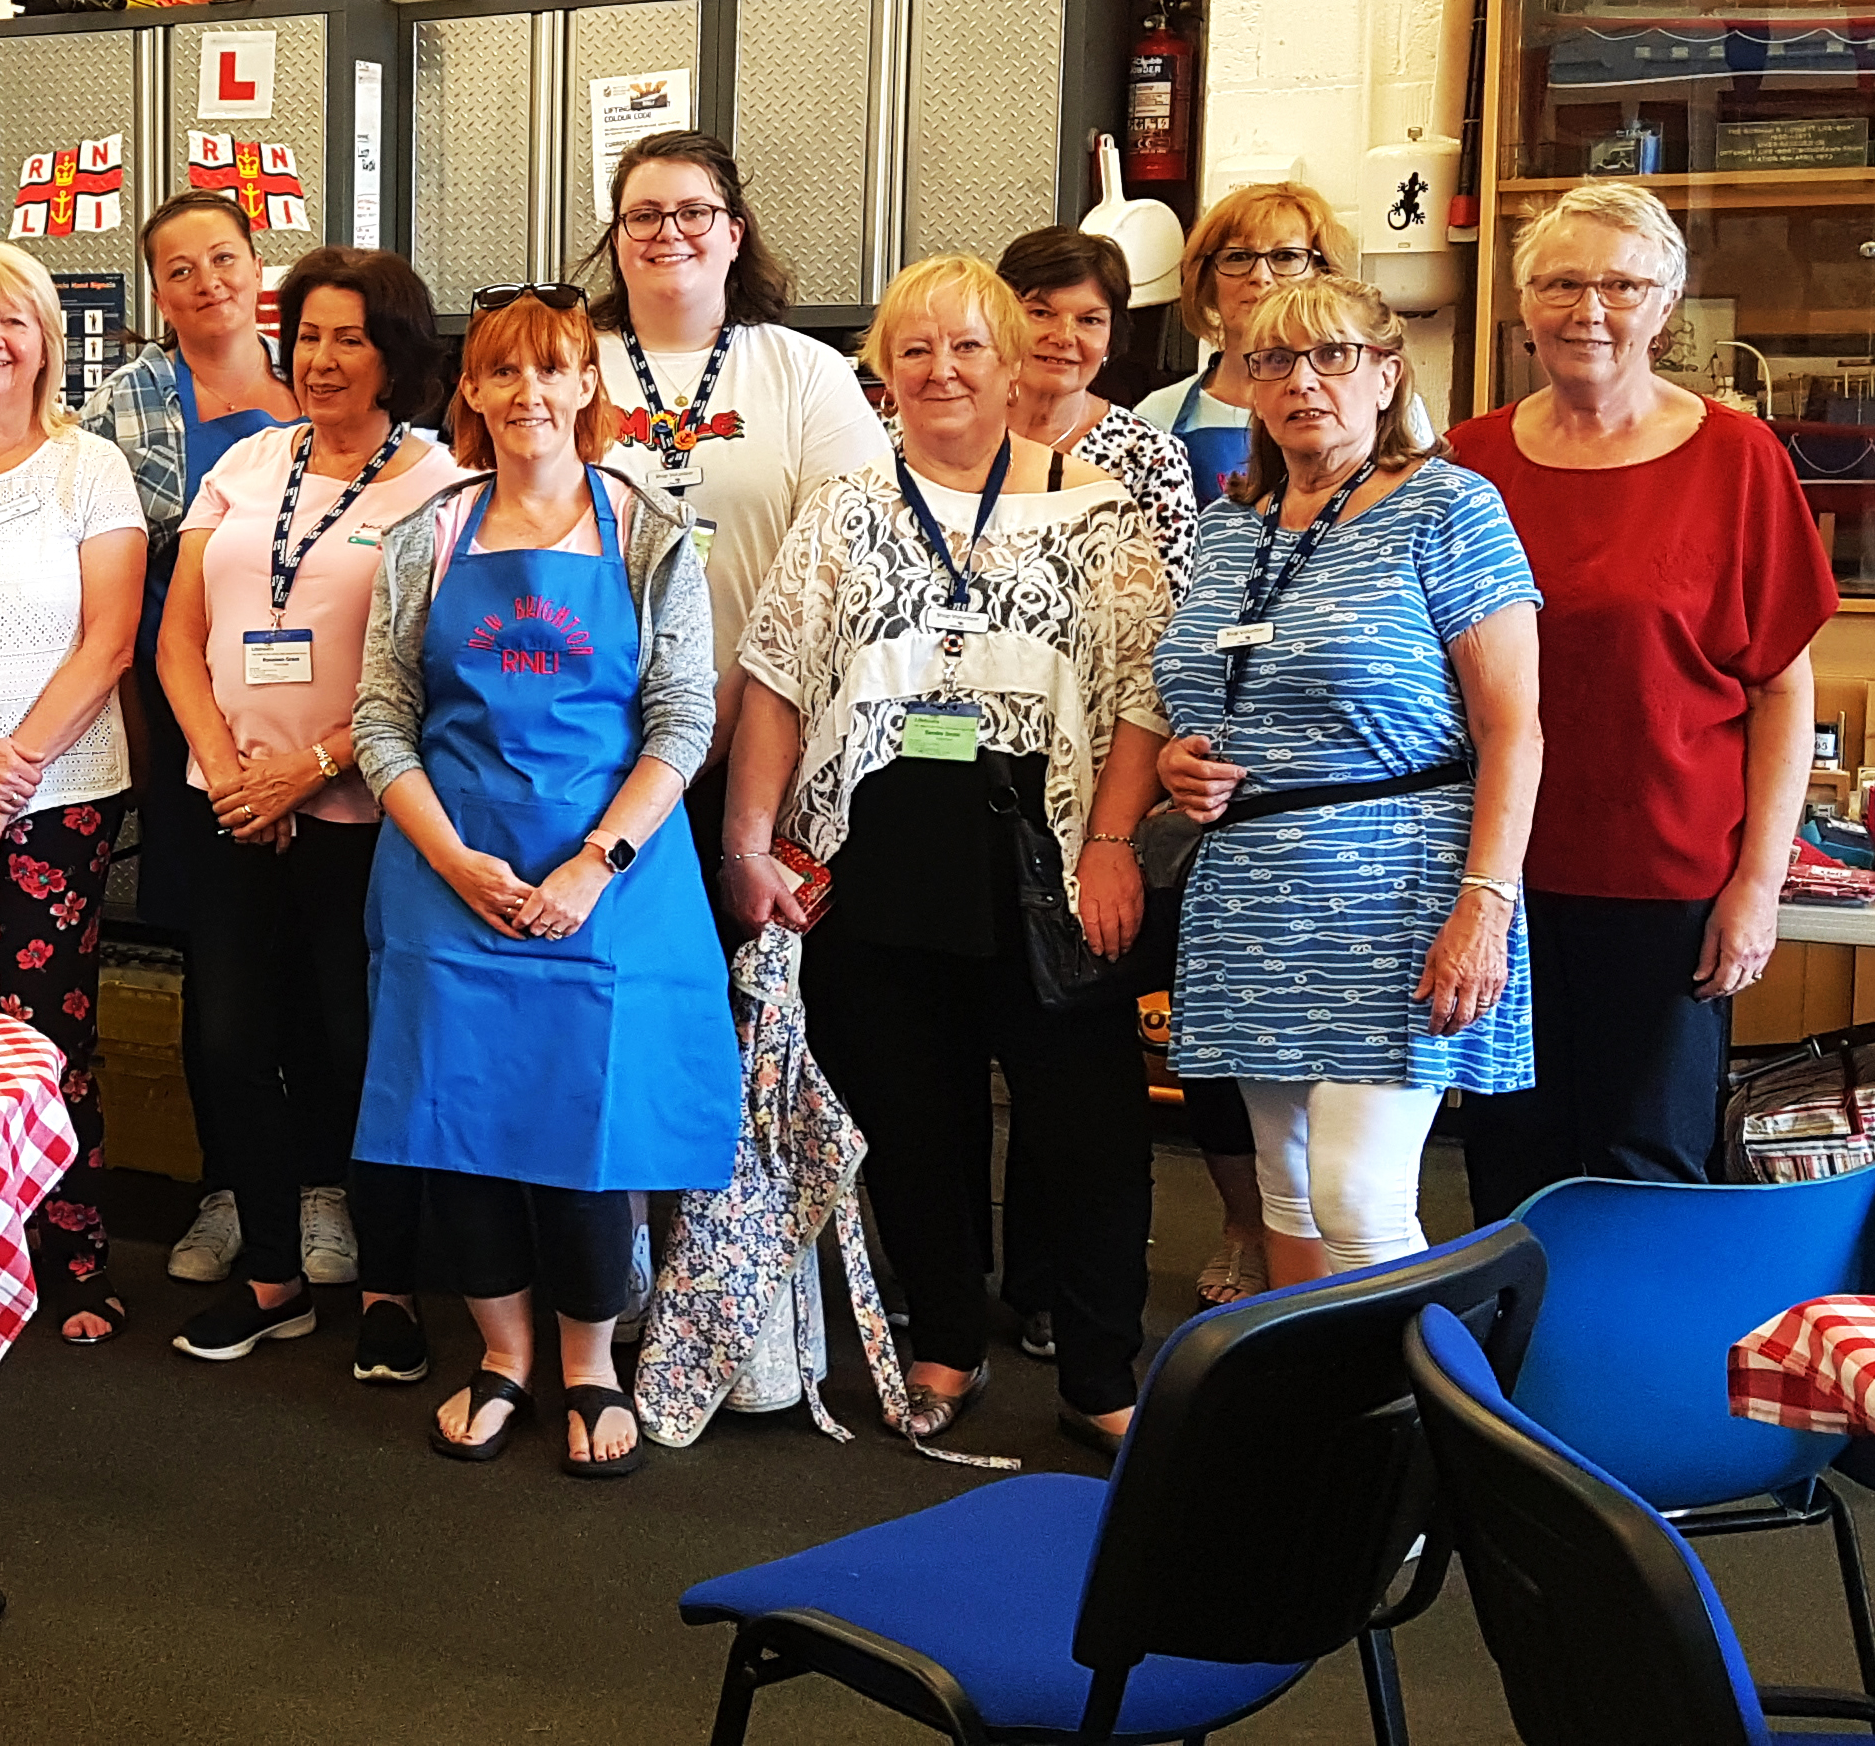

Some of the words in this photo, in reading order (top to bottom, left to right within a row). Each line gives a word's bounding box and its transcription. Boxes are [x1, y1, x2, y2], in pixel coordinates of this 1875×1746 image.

[219, 51, 255, 100] L
[28, 157, 44, 179] R
[92, 142, 108, 167] N
[202, 136, 219, 161] R
[271, 146, 288, 169] N
[21, 209, 36, 232] L
[468, 614, 504, 650] NEW
[514, 595, 594, 656] BRIGHTON
[501, 648, 560, 674] RNLI
